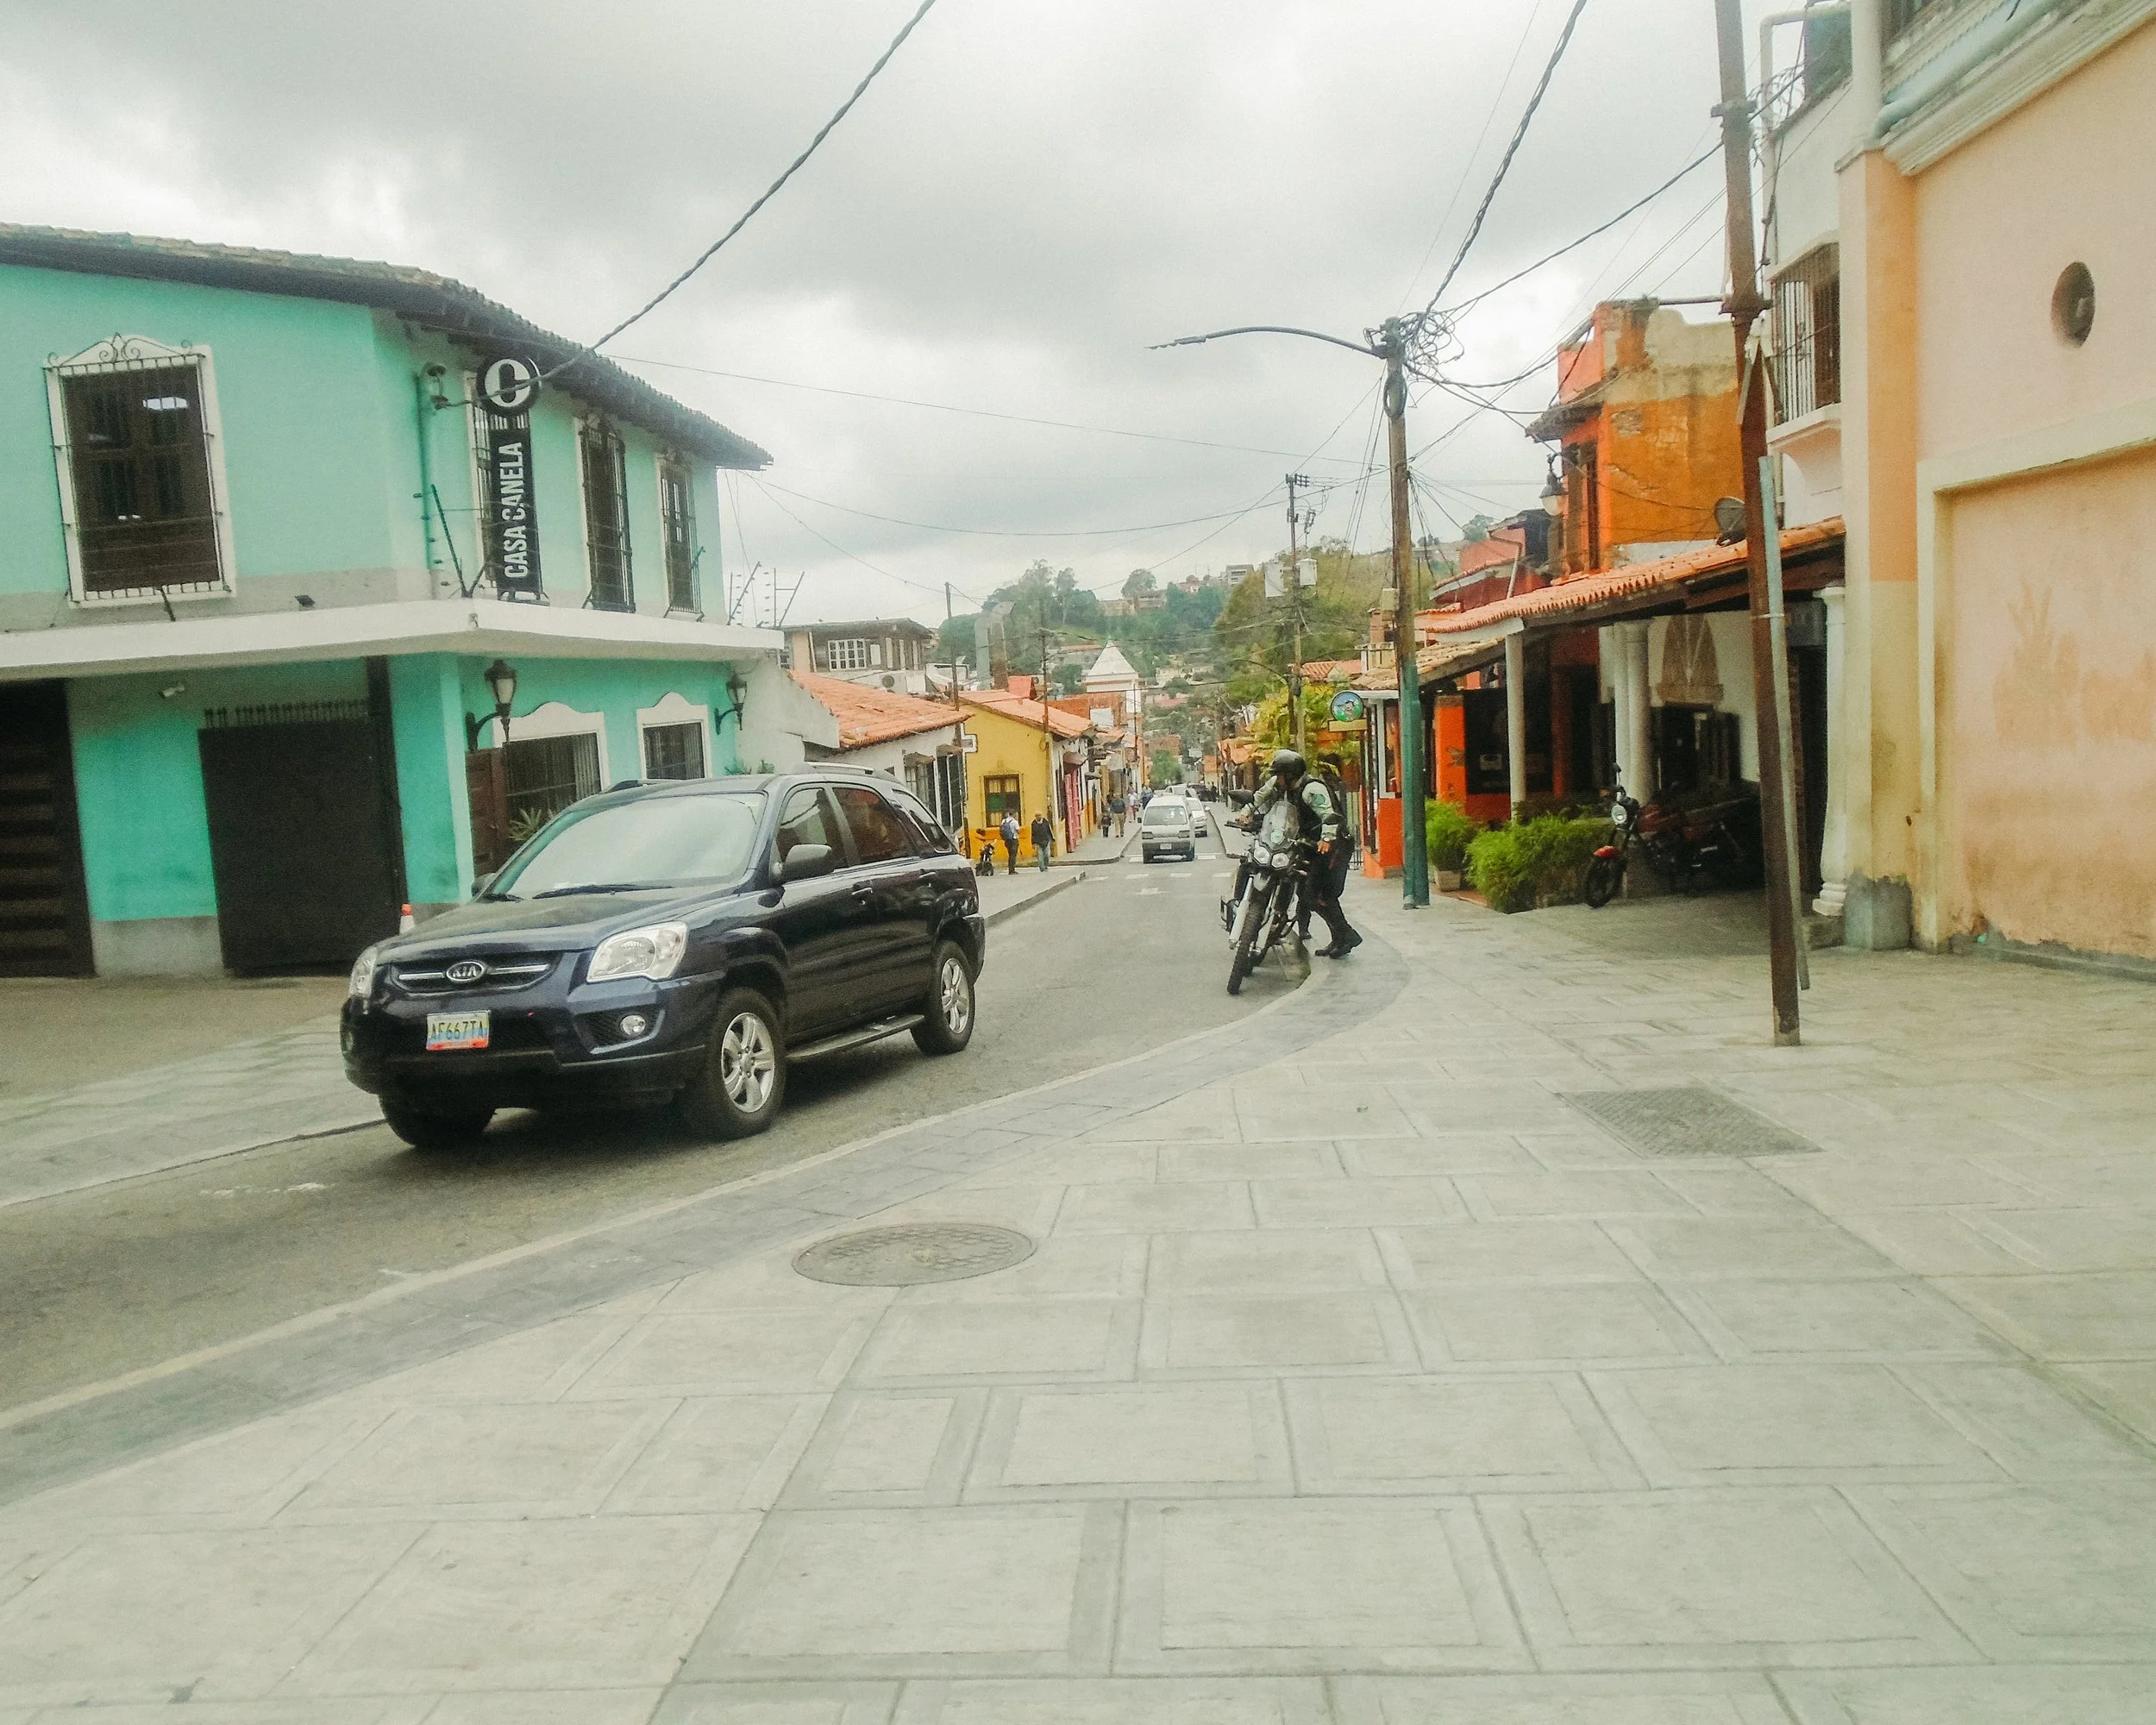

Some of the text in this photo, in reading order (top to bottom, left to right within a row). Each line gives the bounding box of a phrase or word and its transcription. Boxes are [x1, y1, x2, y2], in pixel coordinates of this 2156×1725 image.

[498, 442, 528, 577] CASA CANELA
[452, 966, 478, 977] KIA
[429, 1020, 486, 1040] AF667TA
